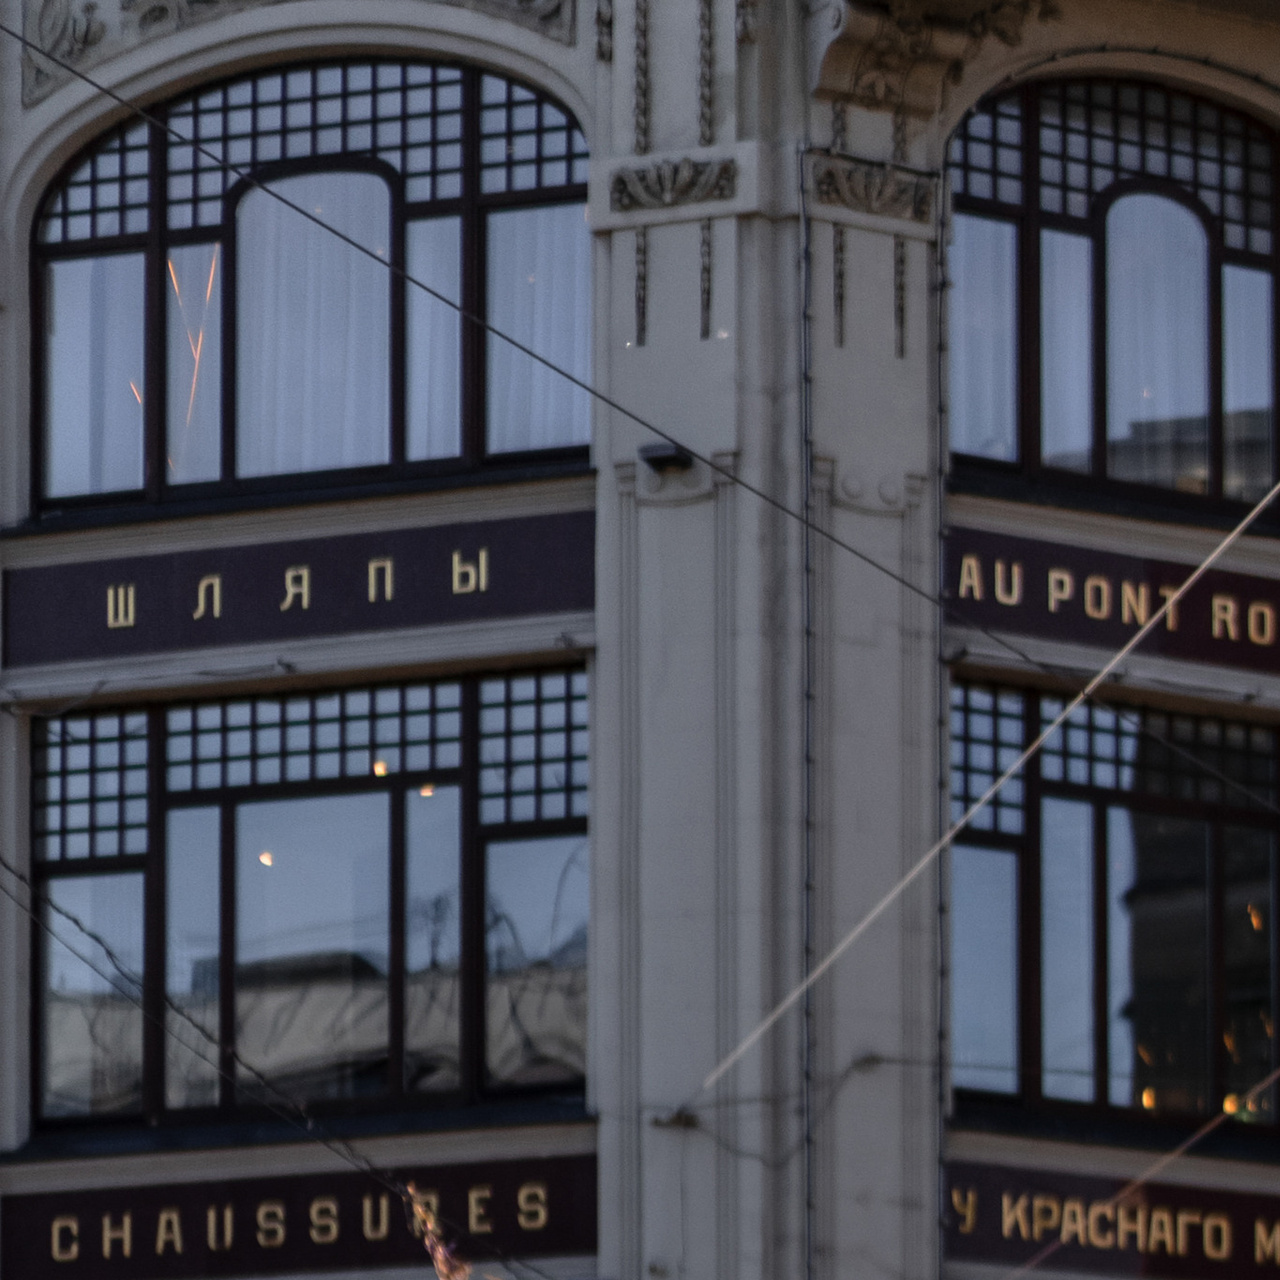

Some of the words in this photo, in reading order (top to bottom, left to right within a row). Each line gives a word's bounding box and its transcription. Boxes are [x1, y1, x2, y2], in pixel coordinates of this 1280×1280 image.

[106, 547, 489, 629] ШЛЯПЫ
[958, 553, 1024, 607] AU
[1047, 567, 1182, 632] PONT
[951, 1187, 979, 1235] У
[1000, 1192, 1234, 1261] КРАСНАГО
